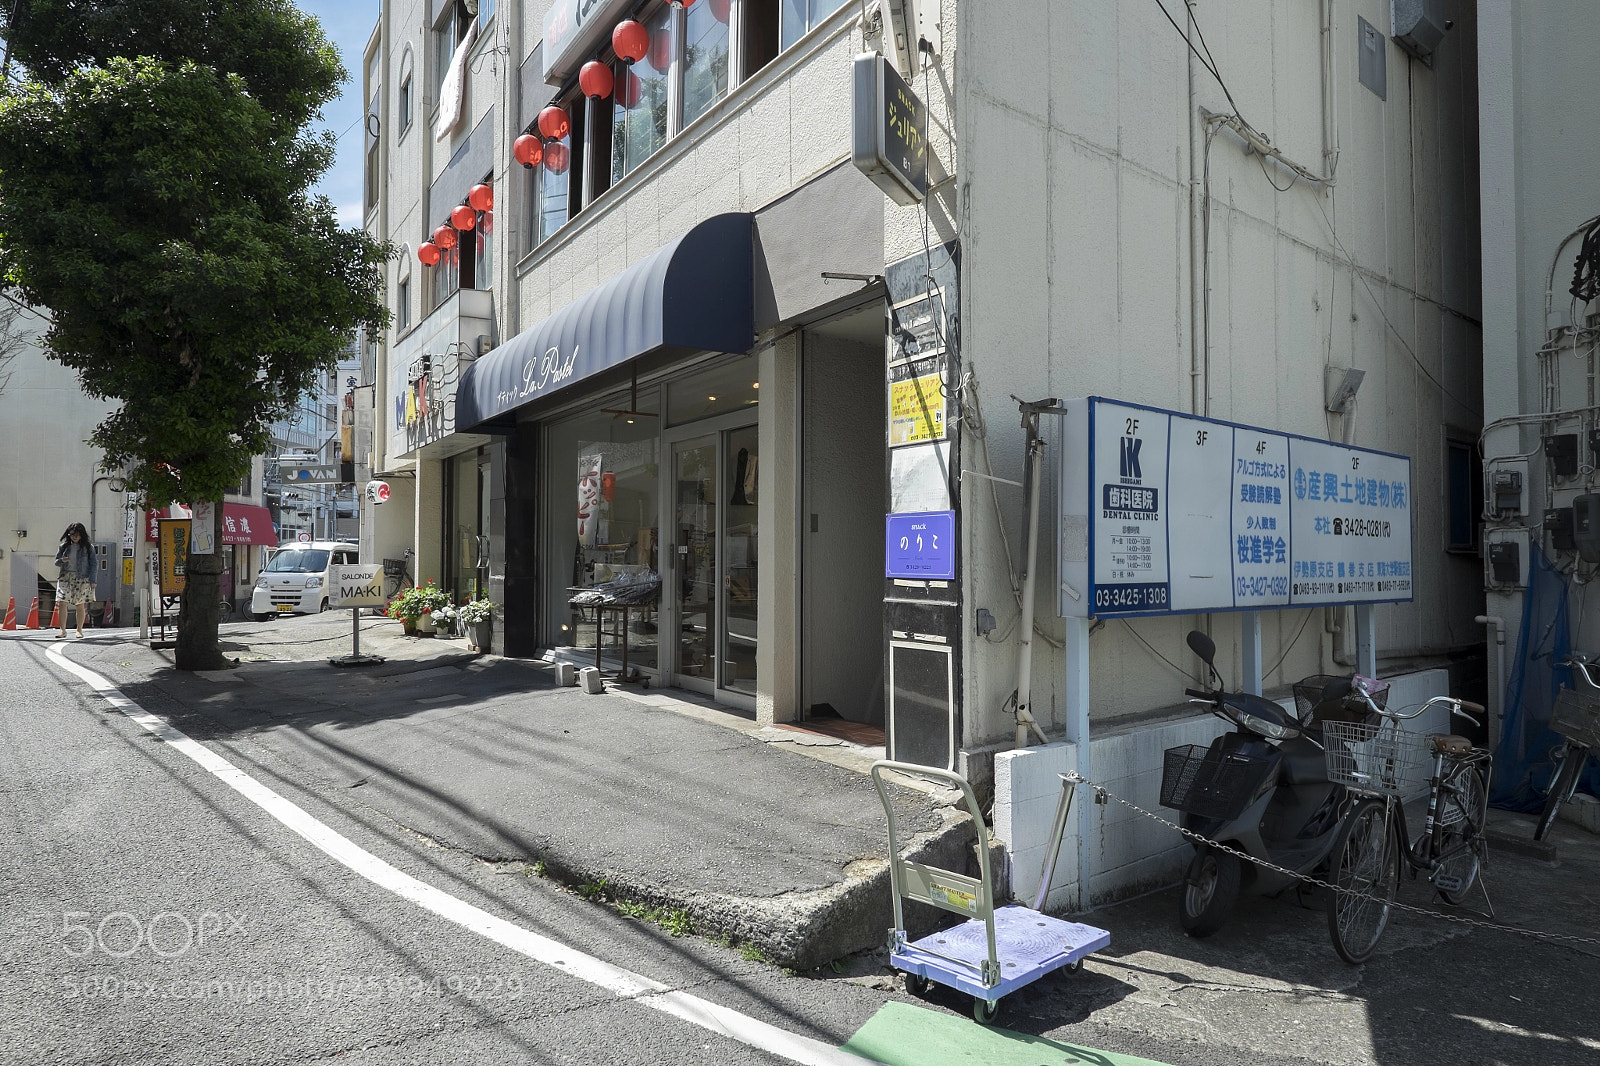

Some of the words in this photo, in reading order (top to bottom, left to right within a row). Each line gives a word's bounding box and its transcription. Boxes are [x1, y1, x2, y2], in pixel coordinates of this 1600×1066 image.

[897, 88, 916, 117] SNACK
[902, 157, 911, 172] B1
[537, 344, 579, 390] Pastel
[1126, 418, 1140, 435] 2F
[1196, 430, 1208, 446] 3F
[1256, 441, 1267, 455] 4F
[1236, 458, 1286, 479] アルゴ方式による
[1351, 457, 1360, 470] 2F
[286, 469, 337, 481] JOVAN
[1109, 487, 1153, 510] 歯科医院
[1240, 484, 1281, 505] 受験読解塾
[1103, 510, 1132, 520] DENTAL
[1133, 512, 1159, 521] CLINIC
[1246, 516, 1277, 531] 少人数制
[1314, 516, 1331, 535] 本社
[900, 533, 939, 552] のりこ
[1237, 534, 1286, 564] 桜進学会
[1293, 560, 1334, 578] 伊勢原支店
[1236, 576, 1288, 597] 03-3427-0392
